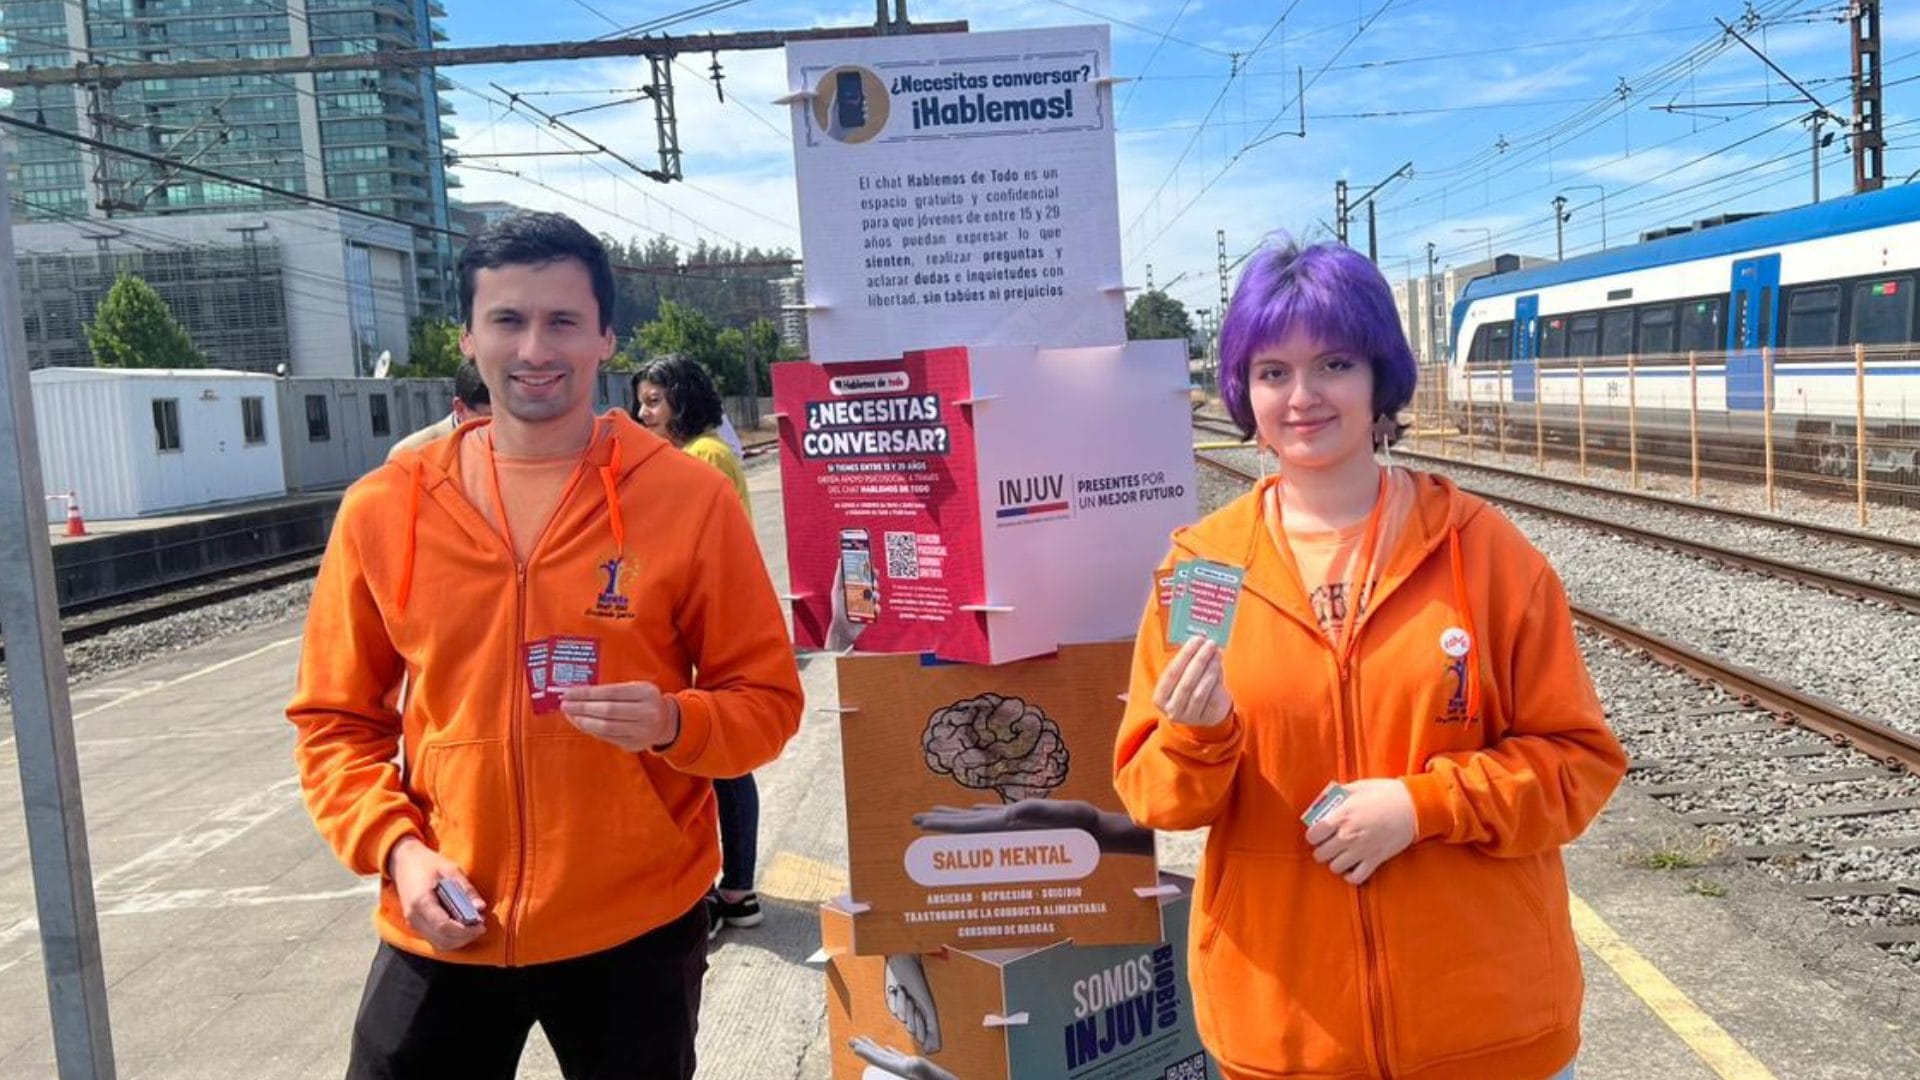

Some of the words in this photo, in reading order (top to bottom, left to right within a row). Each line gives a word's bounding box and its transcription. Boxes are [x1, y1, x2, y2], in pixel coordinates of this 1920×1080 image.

[891, 72, 988, 96] ¿Necesitas
[992, 65, 1091, 88] conversar?
[911, 89, 1074, 130] ¡Hablemos!
[859, 176, 870, 190] El
[875, 176, 902, 189] chat
[907, 173, 966, 187] Hablemos
[971, 171, 986, 184] de
[991, 169, 1018, 182] Todo
[1024, 171, 1037, 181] es
[1043, 169, 1058, 180] un
[861, 195, 907, 211] espacio
[915, 192, 963, 209] gratuito
[971, 193, 978, 206] y
[986, 186, 1059, 203] confidencial
[862, 217, 889, 232] para
[892, 216, 913, 230] que
[917, 212, 963, 228] jóvenes
[966, 210, 981, 224] de
[984, 209, 1016, 222] entre
[1020, 207, 1032, 220] 15
[1035, 209, 1042, 222] y
[1045, 205, 1060, 219] 29
[864, 236, 892, 249] años
[902, 233, 946, 249] puedan
[956, 230, 1008, 245] expresar
[1018, 227, 1029, 239] lo
[1039, 227, 1061, 240] que
[865, 253, 914, 269] sienten,
[926, 250, 971, 266] realizar
[983, 248, 1044, 264] preguntas
[867, 273, 908, 288] aclarar
[914, 271, 950, 285] dudas
[954, 272, 961, 282] e
[966, 267, 1037, 284] inquietudes
[1042, 265, 1064, 277] con
[922, 290, 942, 304] sin
[945, 287, 985, 303] tabúes
[989, 287, 1000, 299] ni
[1003, 283, 1064, 300] prejuicios
[809, 396, 937, 429] ¿NECESITAS
[804, 427, 947, 456] CONVERSAR?
[999, 474, 1063, 505] INJUV
[1078, 474, 1140, 493] PRESENTES
[1142, 471, 1165, 485] POR
[1079, 497, 1095, 509] UN
[1098, 492, 1137, 507] MEJOR
[1139, 485, 1184, 501] FUTURO
[933, 851, 993, 870] SALUD
[1001, 844, 1072, 867] MENTAL
[927, 893, 973, 904] ANSIEDAD
[981, 889, 1033, 902] DEPRESIÓN
[1042, 887, 1082, 899] SUICIDIO
[904, 911, 965, 923] TRASTORNOS
[967, 910, 979, 920] DE
[980, 909, 993, 919] LA
[994, 906, 1042, 918] CONDUCTA
[1043, 903, 1106, 916] ALIMENTARIA
[958, 926, 1003, 937] CONSUMO
[1004, 926, 1016, 935] DE
[1017, 923, 1055, 935] DROGAS
[1074, 954, 1152, 1018] SOMOS
[1065, 991, 1154, 1070] INJUV
